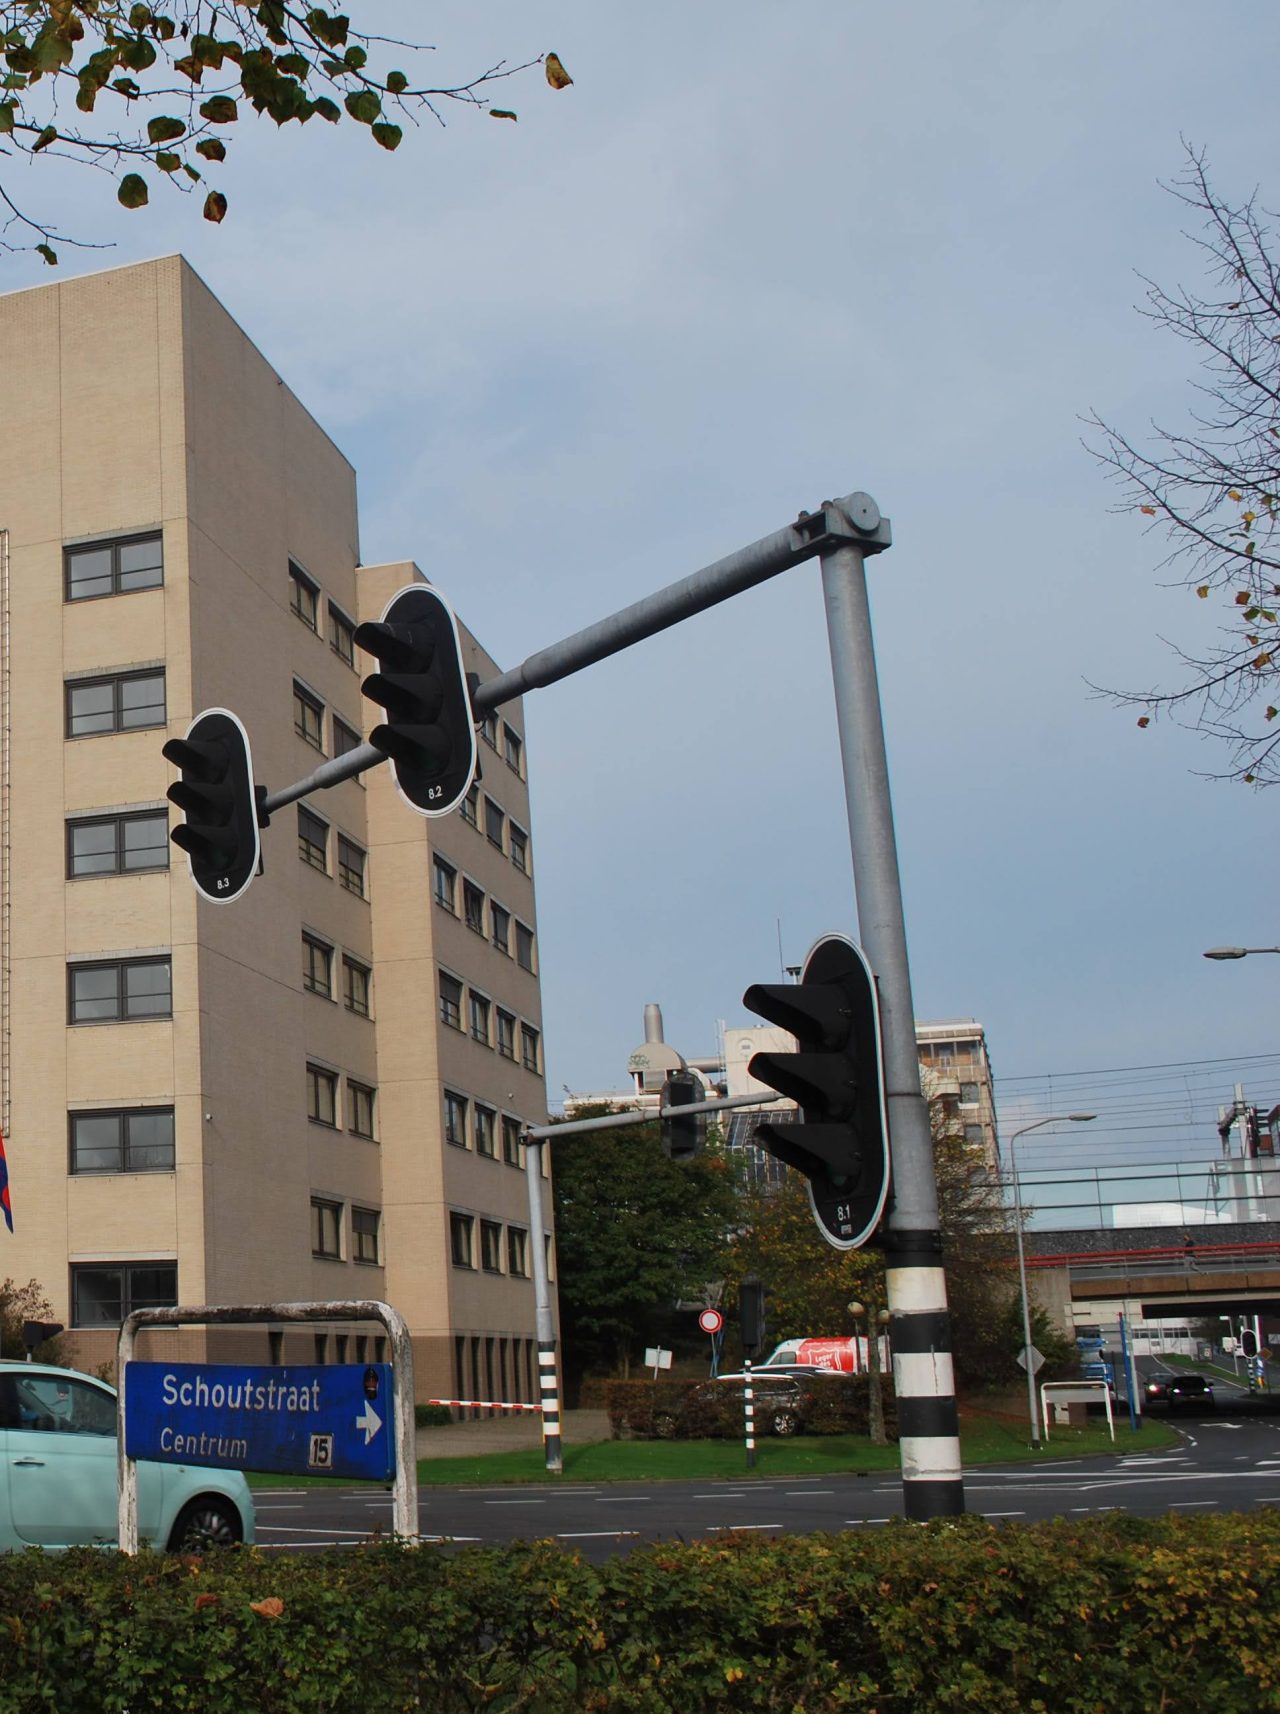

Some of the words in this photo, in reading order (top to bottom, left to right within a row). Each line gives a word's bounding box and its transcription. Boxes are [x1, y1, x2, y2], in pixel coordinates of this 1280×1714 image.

[428, 785, 443, 800] 8.2
[217, 877, 230, 890] 8.3
[837, 1204, 850, 1221] 8.1
[162, 1374, 320, 1412] Schoutstraat
[160, 1427, 248, 1459] Centrum
[312, 1438, 329, 1464] 15
